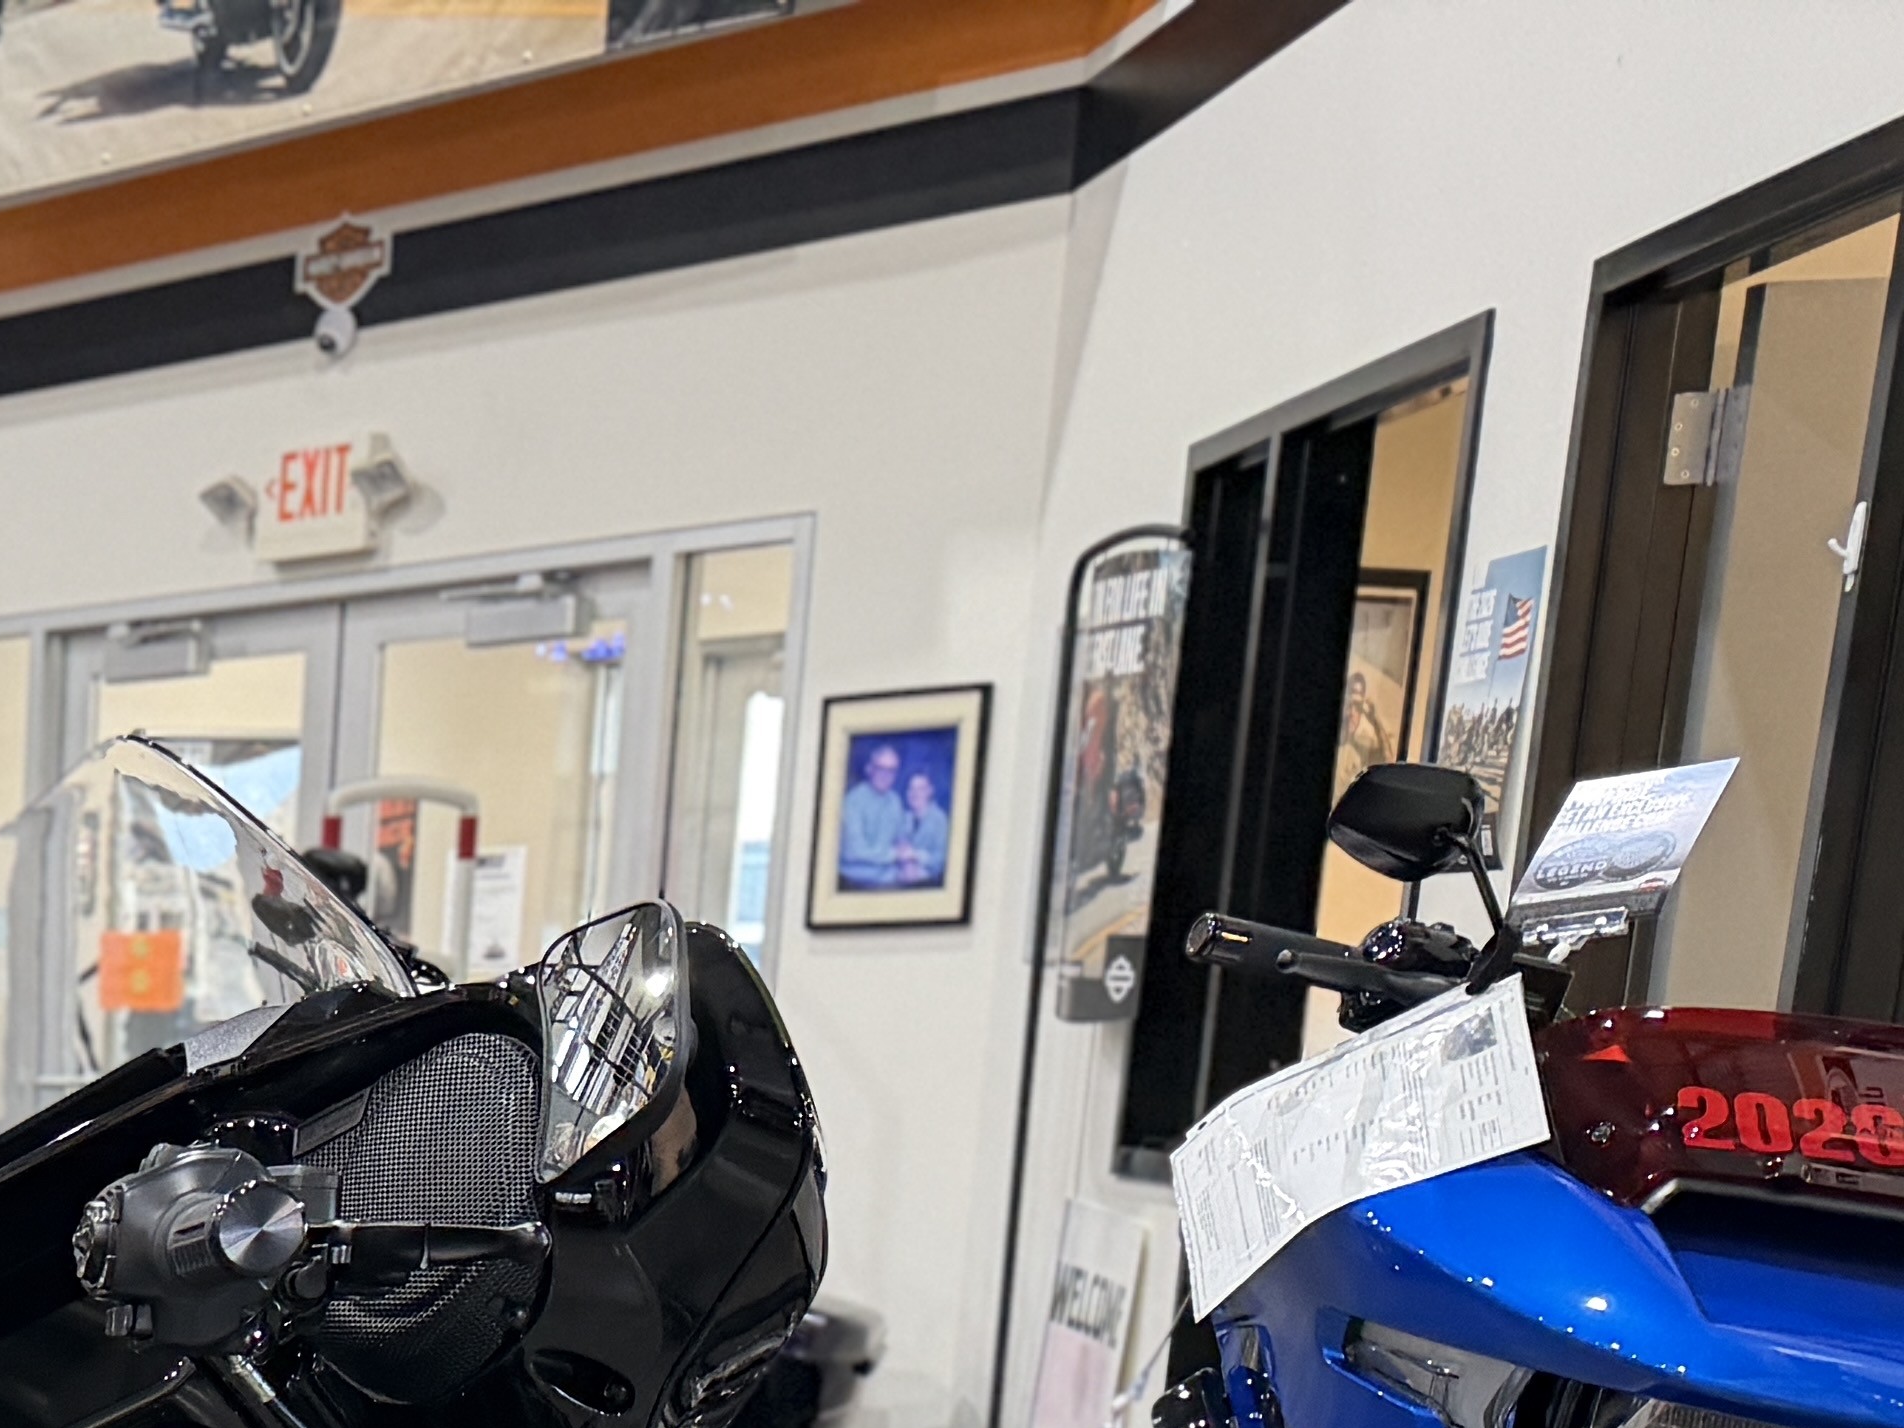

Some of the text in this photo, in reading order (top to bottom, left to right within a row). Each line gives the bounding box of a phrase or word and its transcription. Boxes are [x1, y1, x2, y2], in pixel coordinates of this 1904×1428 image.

[279, 444, 352, 522] EXIT
[1535, 859, 1609, 880] LEGEND
[1050, 1263, 1128, 1346] WELCOME
